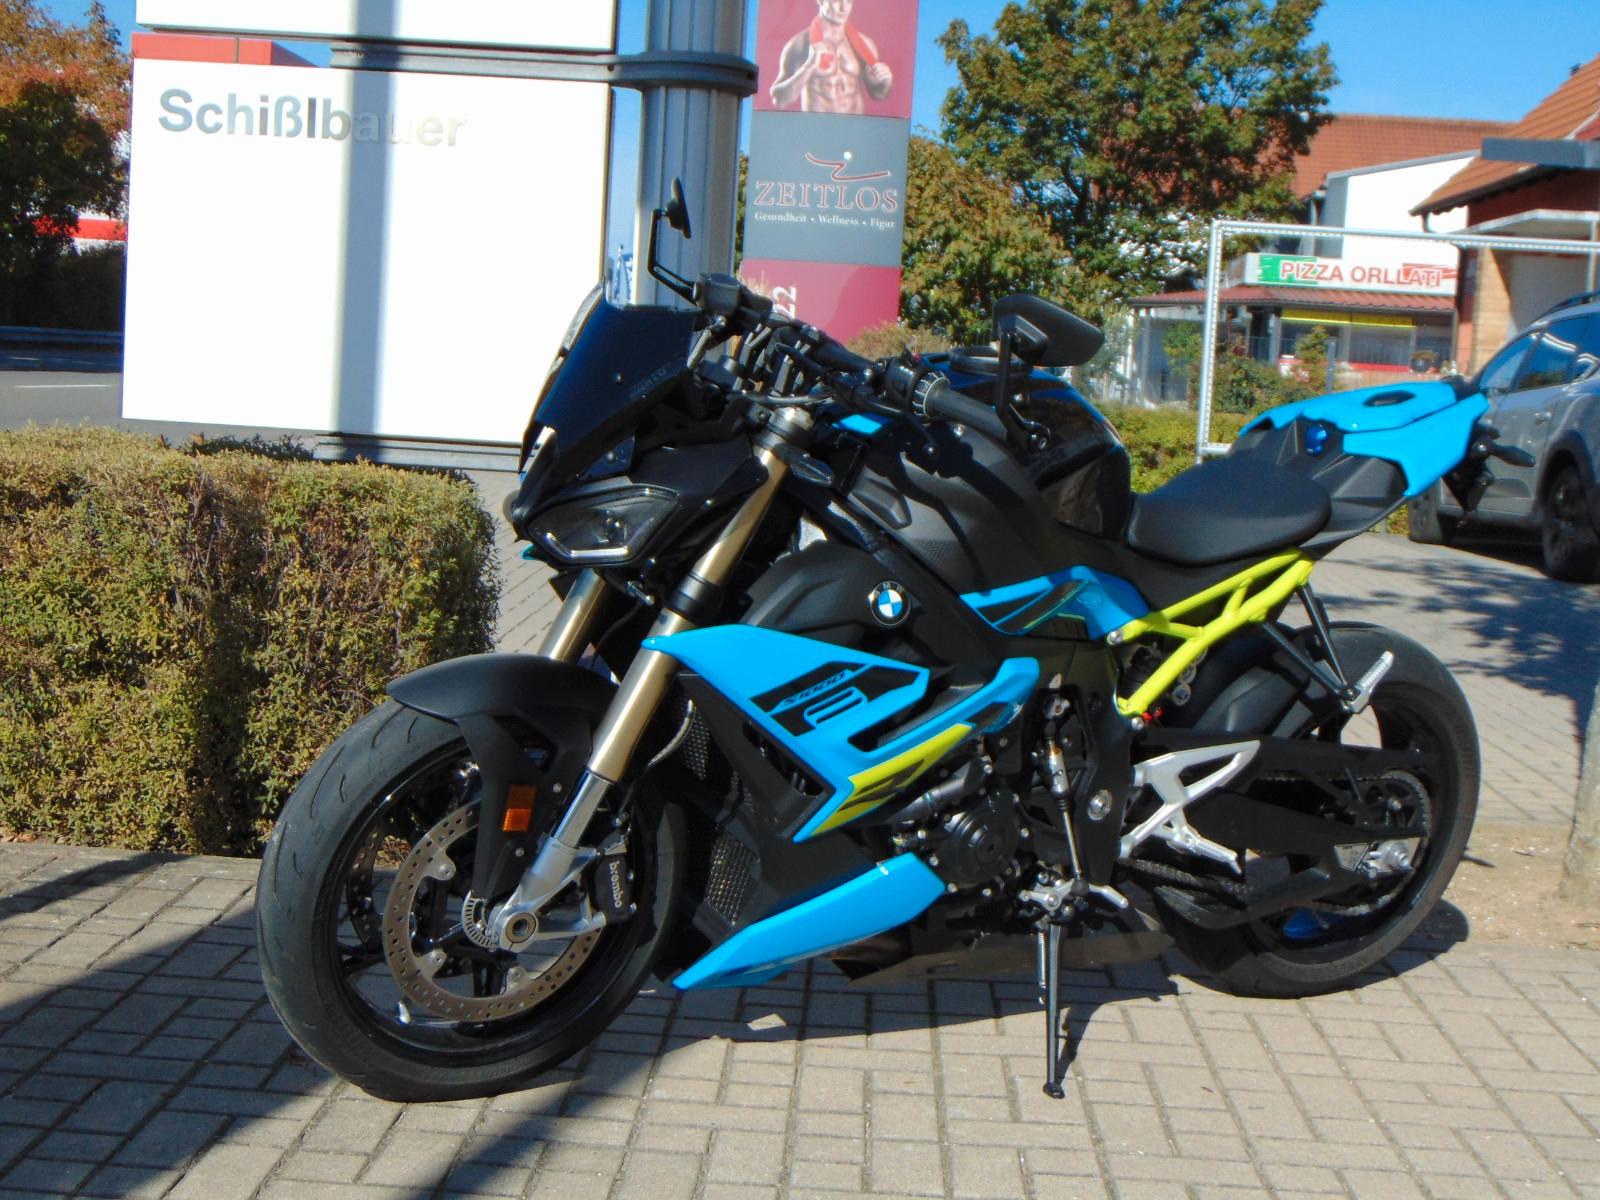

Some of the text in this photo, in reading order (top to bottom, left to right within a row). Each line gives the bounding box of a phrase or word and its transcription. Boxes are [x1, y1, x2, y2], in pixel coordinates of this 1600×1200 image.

[158, 88, 466, 147] Schißlbauer
[754, 181, 898, 213] ZEITLOS
[754, 211, 896, 231] Gesundheit Wellness Figur
[1281, 262, 1344, 282] PIZZA
[609, 860, 624, 908] brembo
